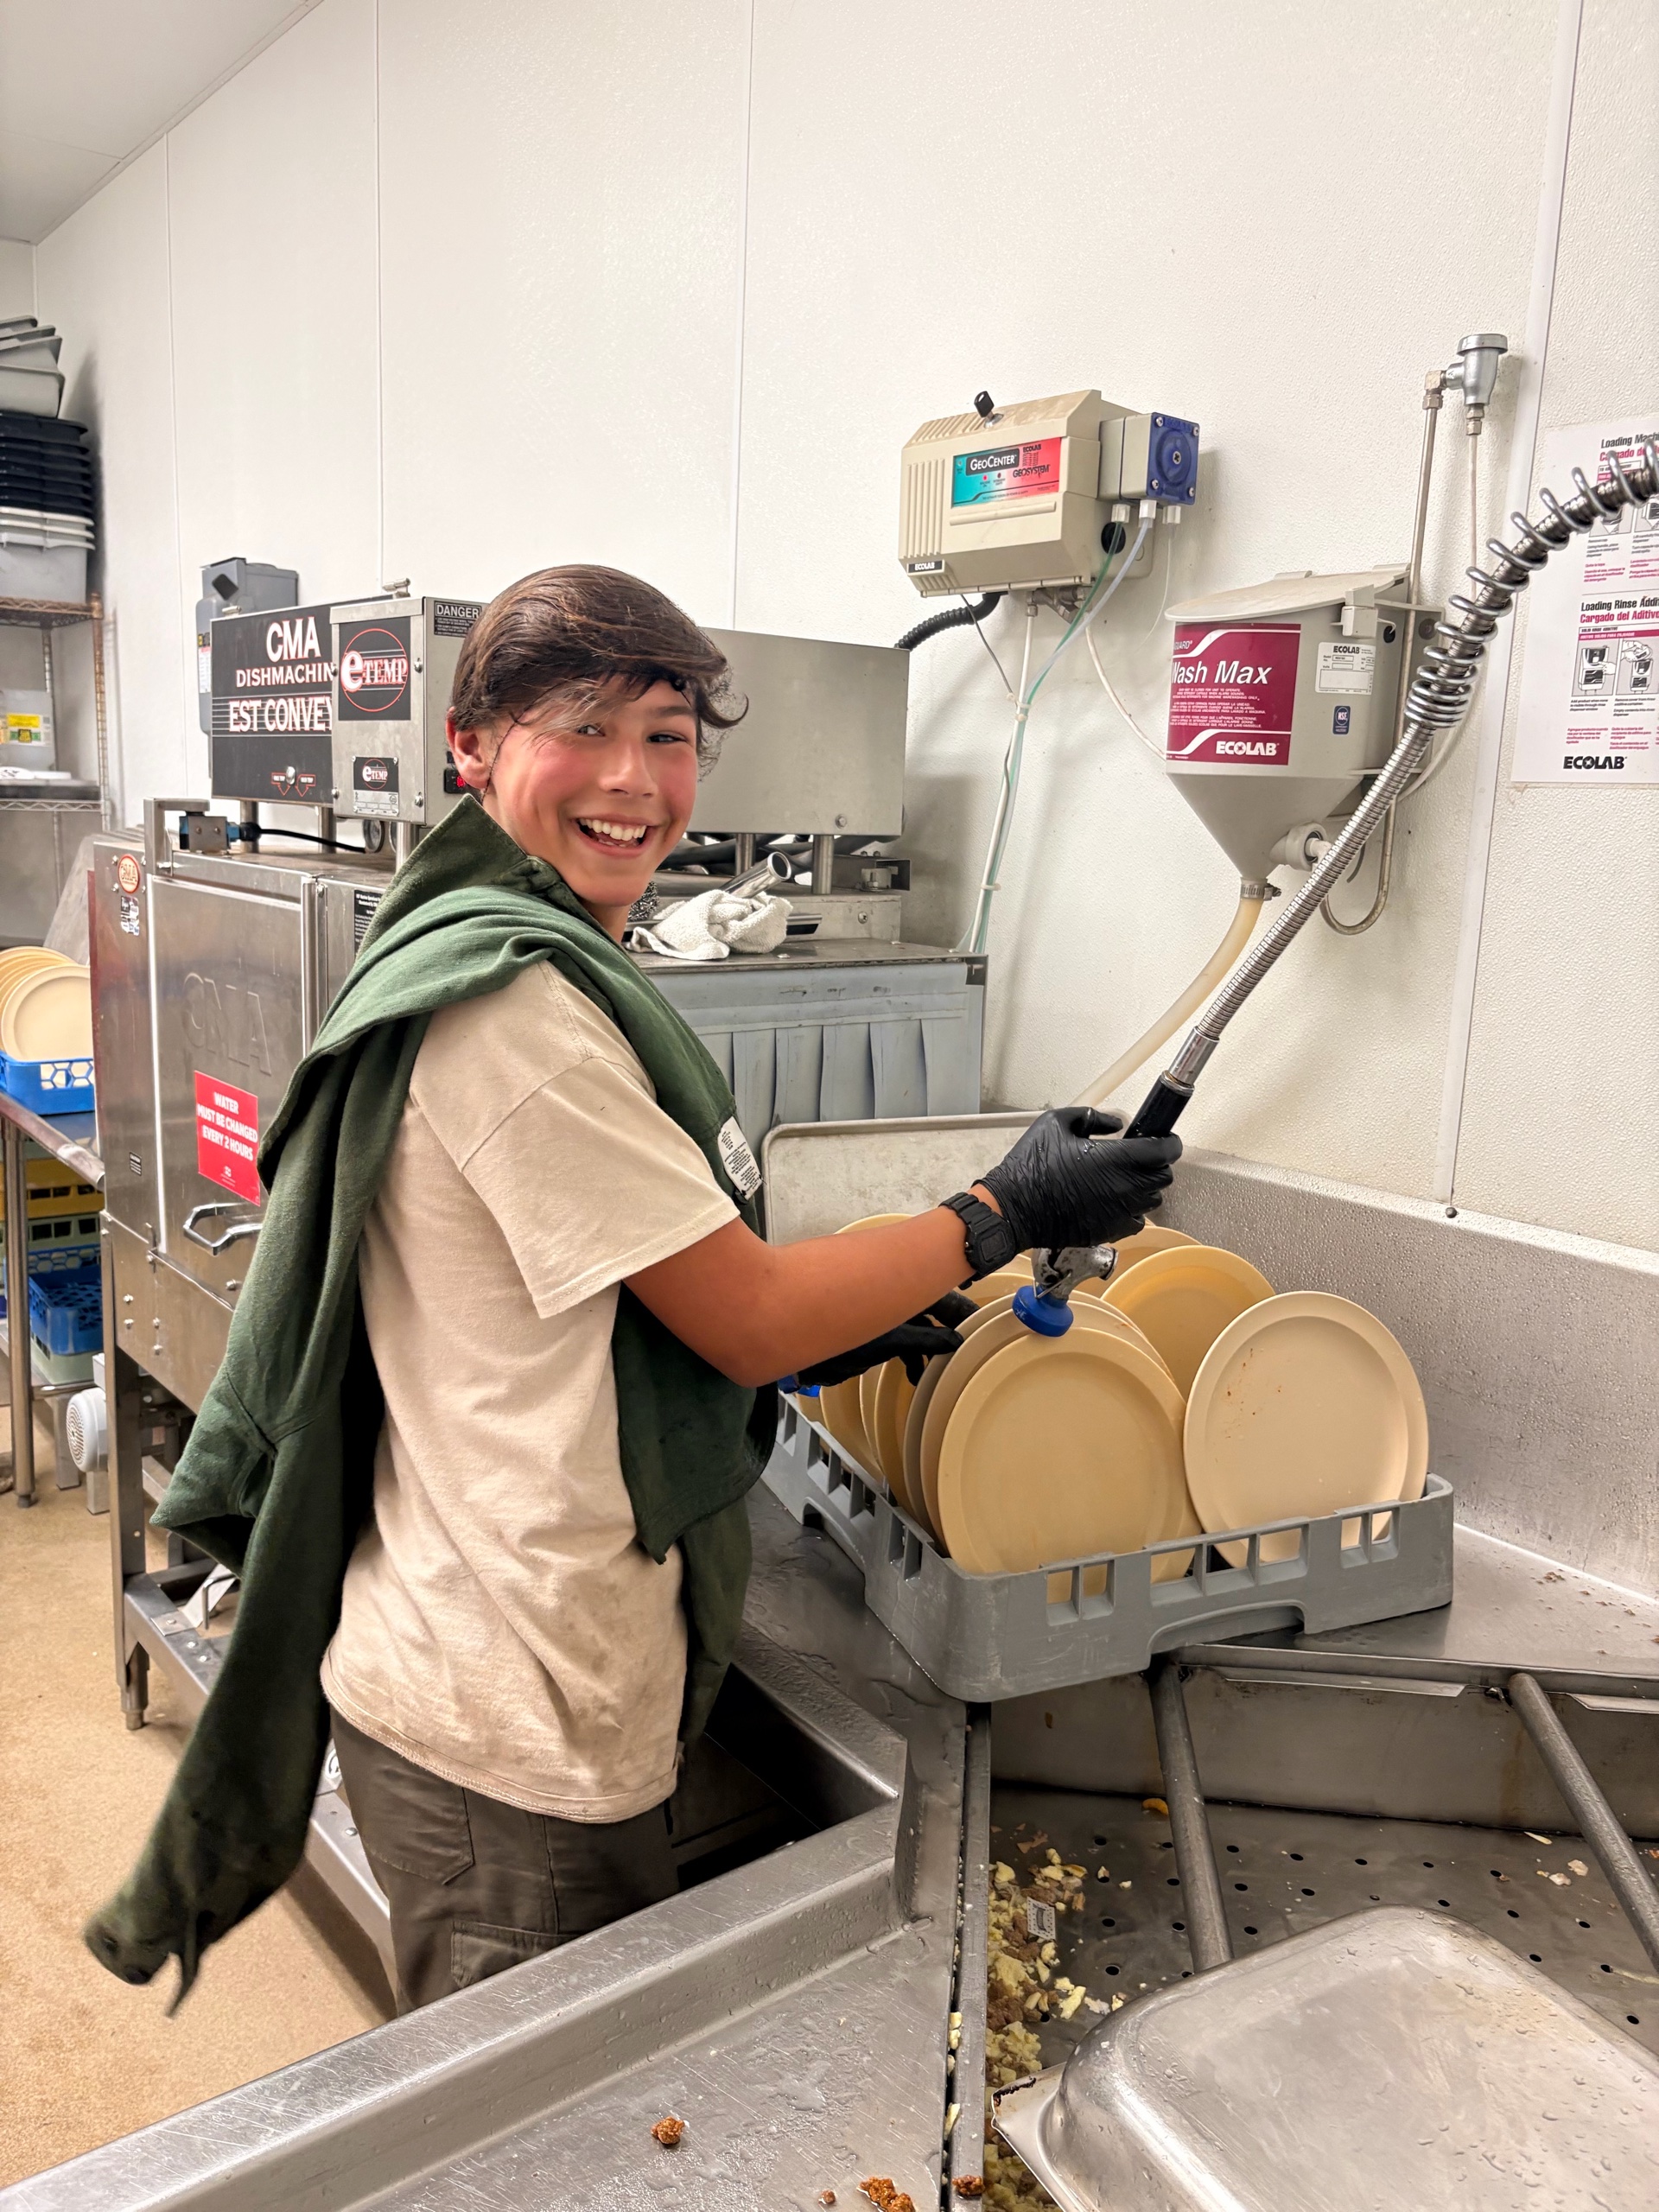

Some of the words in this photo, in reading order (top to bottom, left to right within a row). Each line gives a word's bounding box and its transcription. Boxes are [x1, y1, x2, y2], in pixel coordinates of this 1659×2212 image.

[1023, 444, 1041, 453] ECOLAB
[1601, 436, 1632, 448] Loading
[915, 562, 935, 571] ECOLAB
[437, 604, 479, 619] DANGER
[1581, 601, 1612, 611] Loading
[1614, 599, 1637, 609] Rinse
[1580, 613, 1615, 623] Cargado
[1617, 611, 1630, 621] del
[266, 616, 321, 662] CMA
[1333, 645, 1360, 654] ECOLAB
[1214, 661, 1272, 684] Max
[229, 699, 261, 732] EST
[1338, 712, 1347, 720] NSF
[1215, 741, 1277, 756] ECOLAB
[1563, 756, 1624, 769] ECOLAB
[213, 1091, 239, 1115] WATER
[197, 1103, 216, 1123] MUST
[216, 1112, 225, 1125] BE
[226, 1117, 258, 1143] CHANGED
[202, 1125, 224, 1147] EVERY
[224, 1135, 230, 1149] 2
[230, 1138, 254, 1162] HOURS
